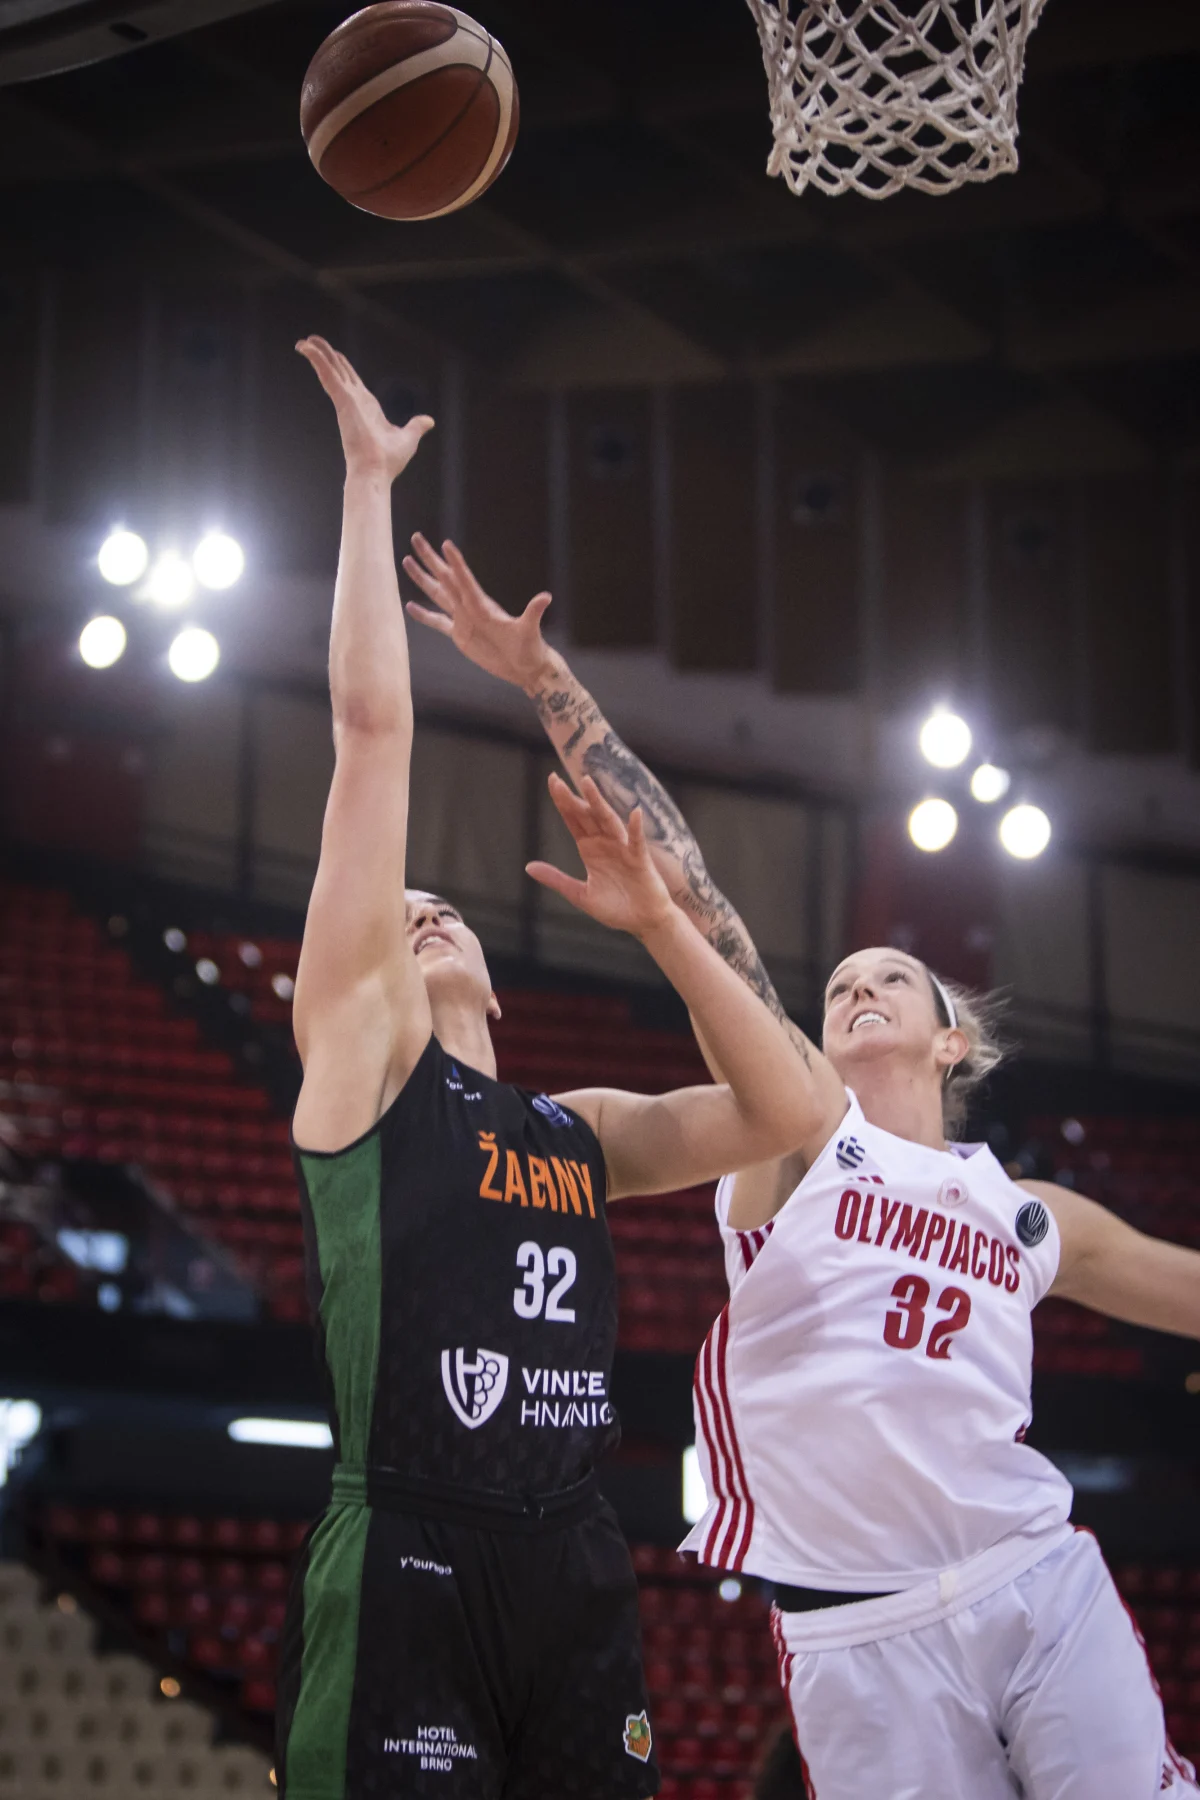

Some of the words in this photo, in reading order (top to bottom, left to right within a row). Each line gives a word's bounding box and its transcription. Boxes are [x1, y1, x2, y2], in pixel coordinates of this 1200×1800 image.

[834, 1188, 1020, 1294] OLYMPIACOS
[513, 1240, 577, 1323] 32
[883, 1274, 971, 1360] 32
[384, 1738, 478, 1759] INTERNATIONAL
[417, 1725, 457, 1742] HOTEL
[420, 1755, 452, 1772] BRNO
